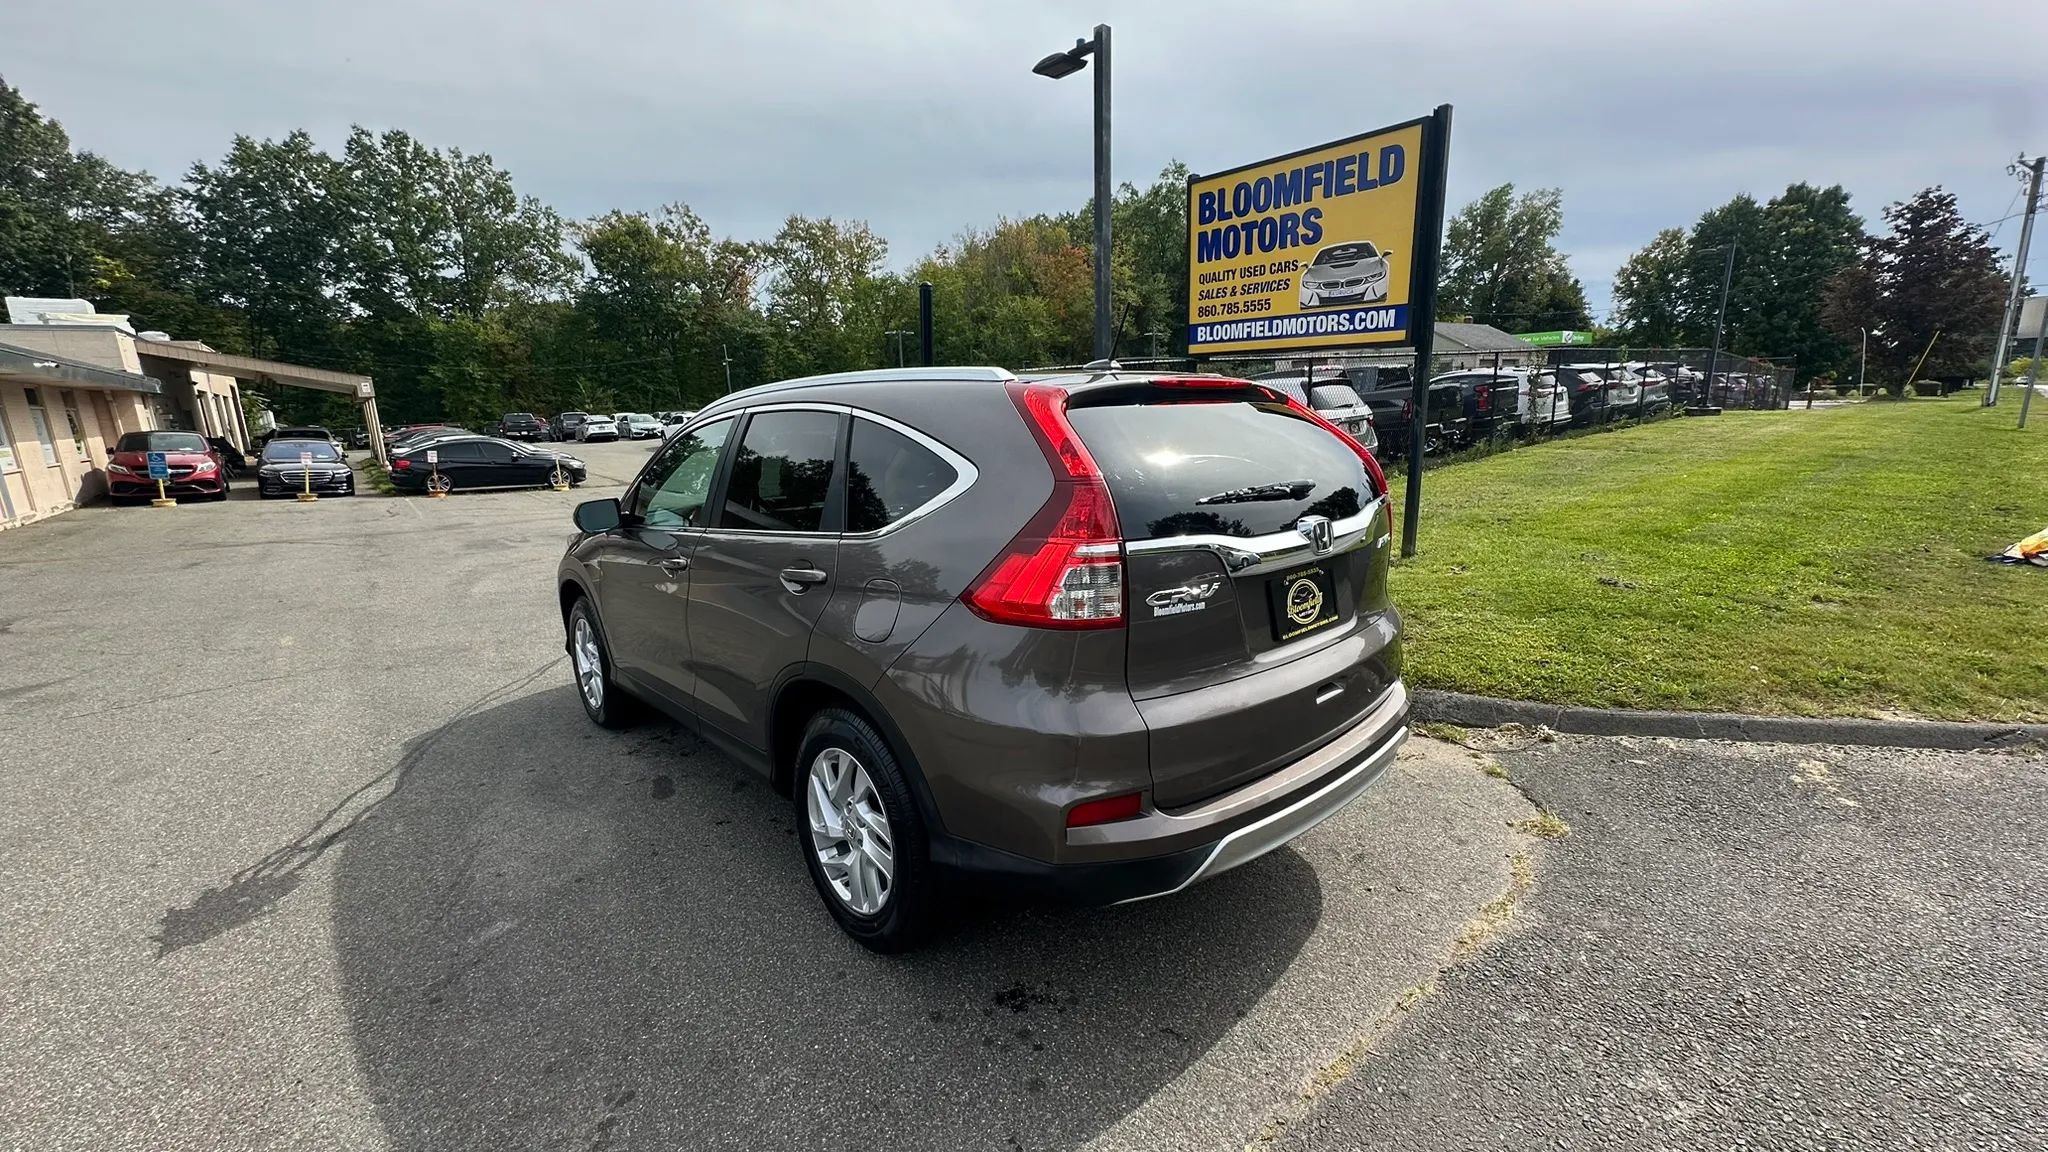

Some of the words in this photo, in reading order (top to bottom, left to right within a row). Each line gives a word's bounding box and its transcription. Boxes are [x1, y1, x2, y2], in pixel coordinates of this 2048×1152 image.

[1198, 144, 1405, 226] BLOOMFIELD
[1197, 208, 1323, 263] MOTORS
[1199, 268, 1237, 285] QUALITY
[1240, 264, 1266, 279] USED
[1269, 259, 1299, 275] CARS
[1198, 287, 1228, 301] SALES
[1229, 285, 1237, 297] &
[1239, 278, 1291, 295] SERVICES
[1197, 299, 1271, 318] 860.785.5555
[1197, 309, 1396, 342] BLOOMFIELDMOTORS.COM
